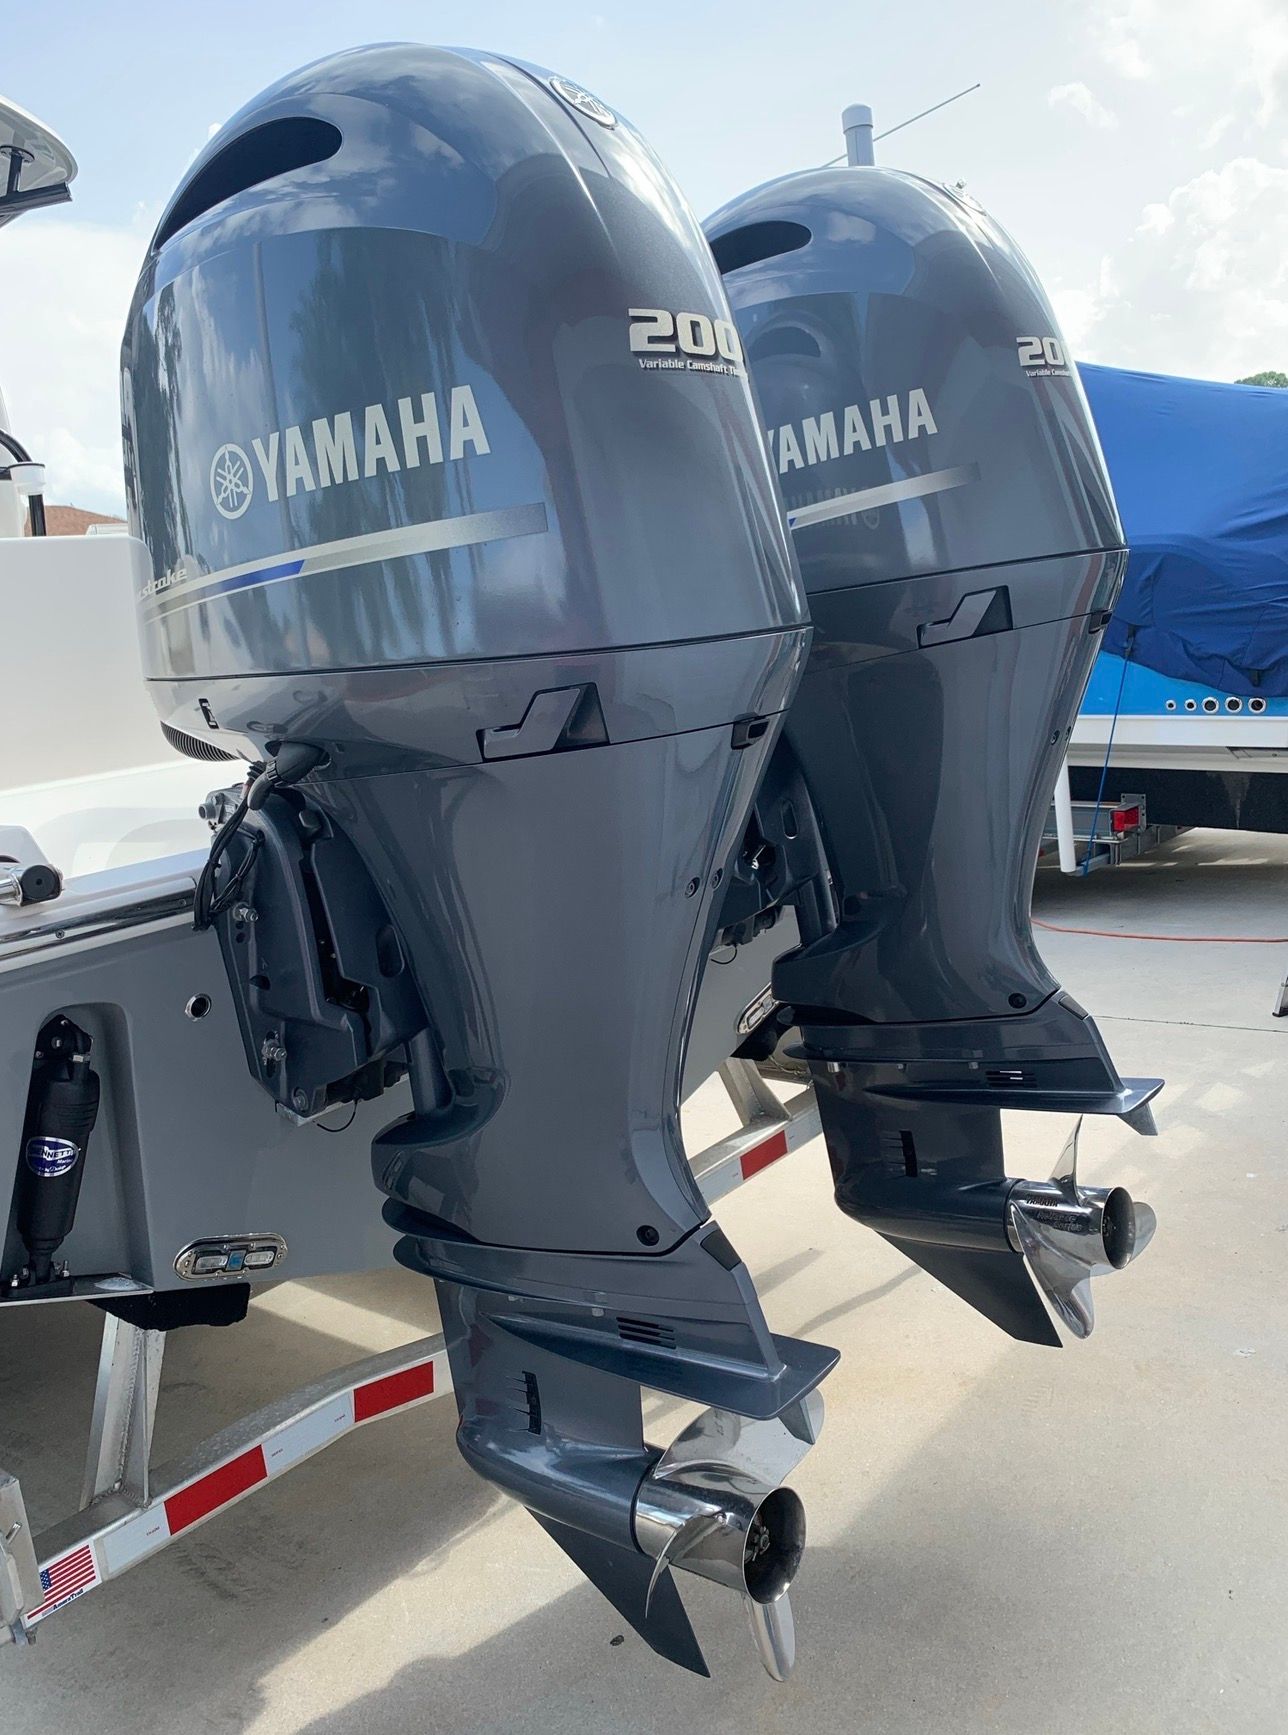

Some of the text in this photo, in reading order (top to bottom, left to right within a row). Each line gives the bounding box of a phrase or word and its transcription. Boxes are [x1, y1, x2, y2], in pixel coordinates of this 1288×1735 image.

[628, 308, 743, 362] 200
[638, 358, 684, 369] Variable
[687, 360, 728, 374] Camshaft
[251, 384, 491, 502] YAMAHA
